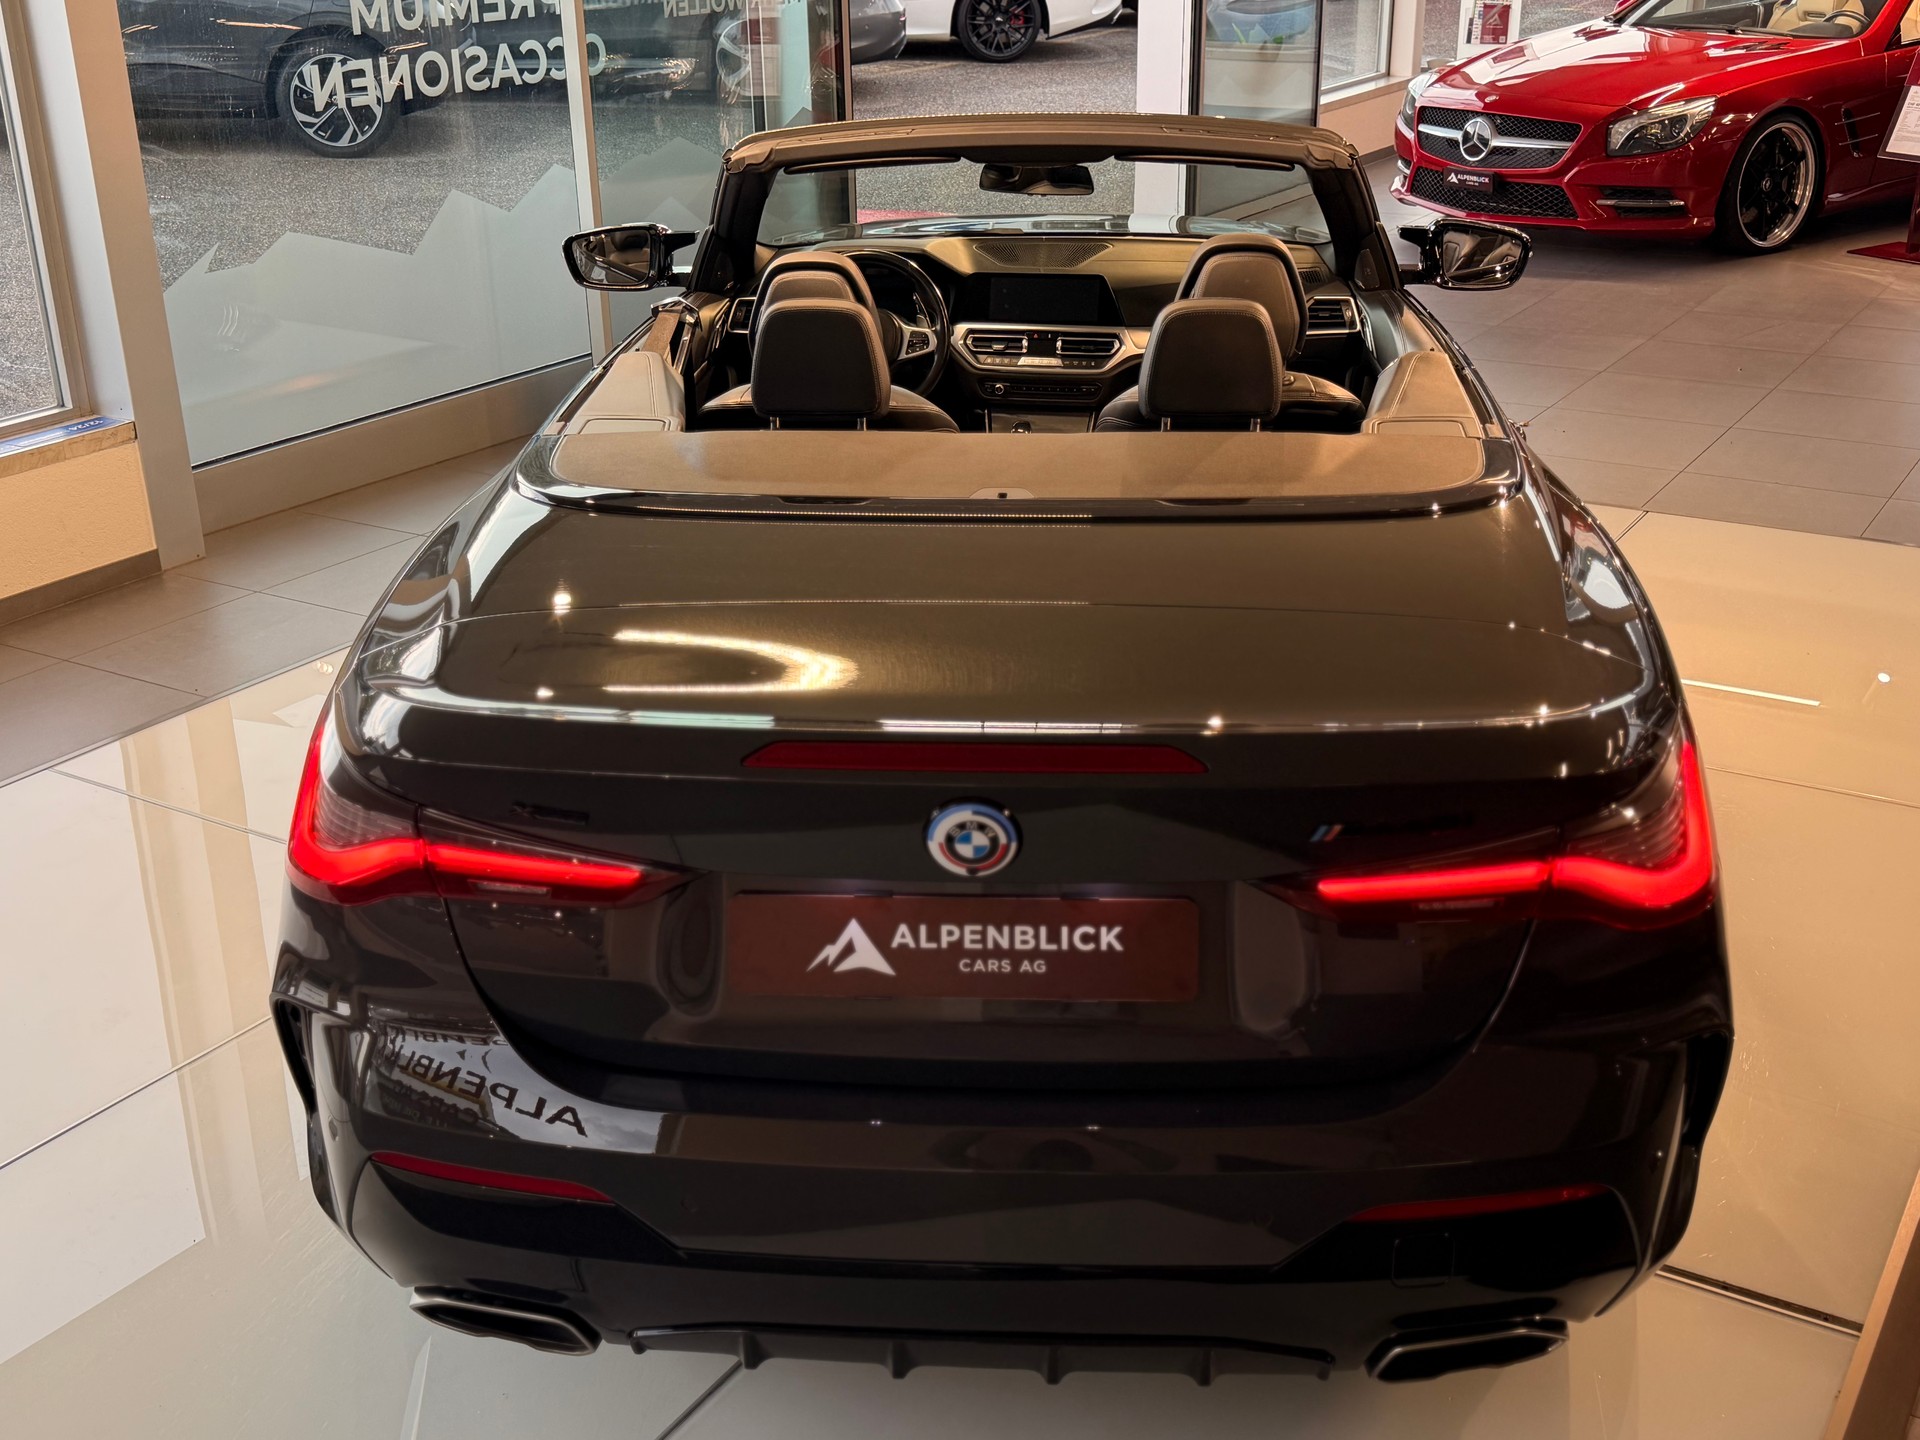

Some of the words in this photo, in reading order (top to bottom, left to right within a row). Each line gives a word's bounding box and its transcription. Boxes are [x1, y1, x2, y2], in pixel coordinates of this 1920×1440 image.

[1457, 174, 1490, 184] ALPENBLICK
[949, 821, 997, 838] BMW
[891, 924, 1124, 952] ALPENBLICK
[959, 959, 1011, 974] CARS
[1020, 960, 1047, 974] AG
